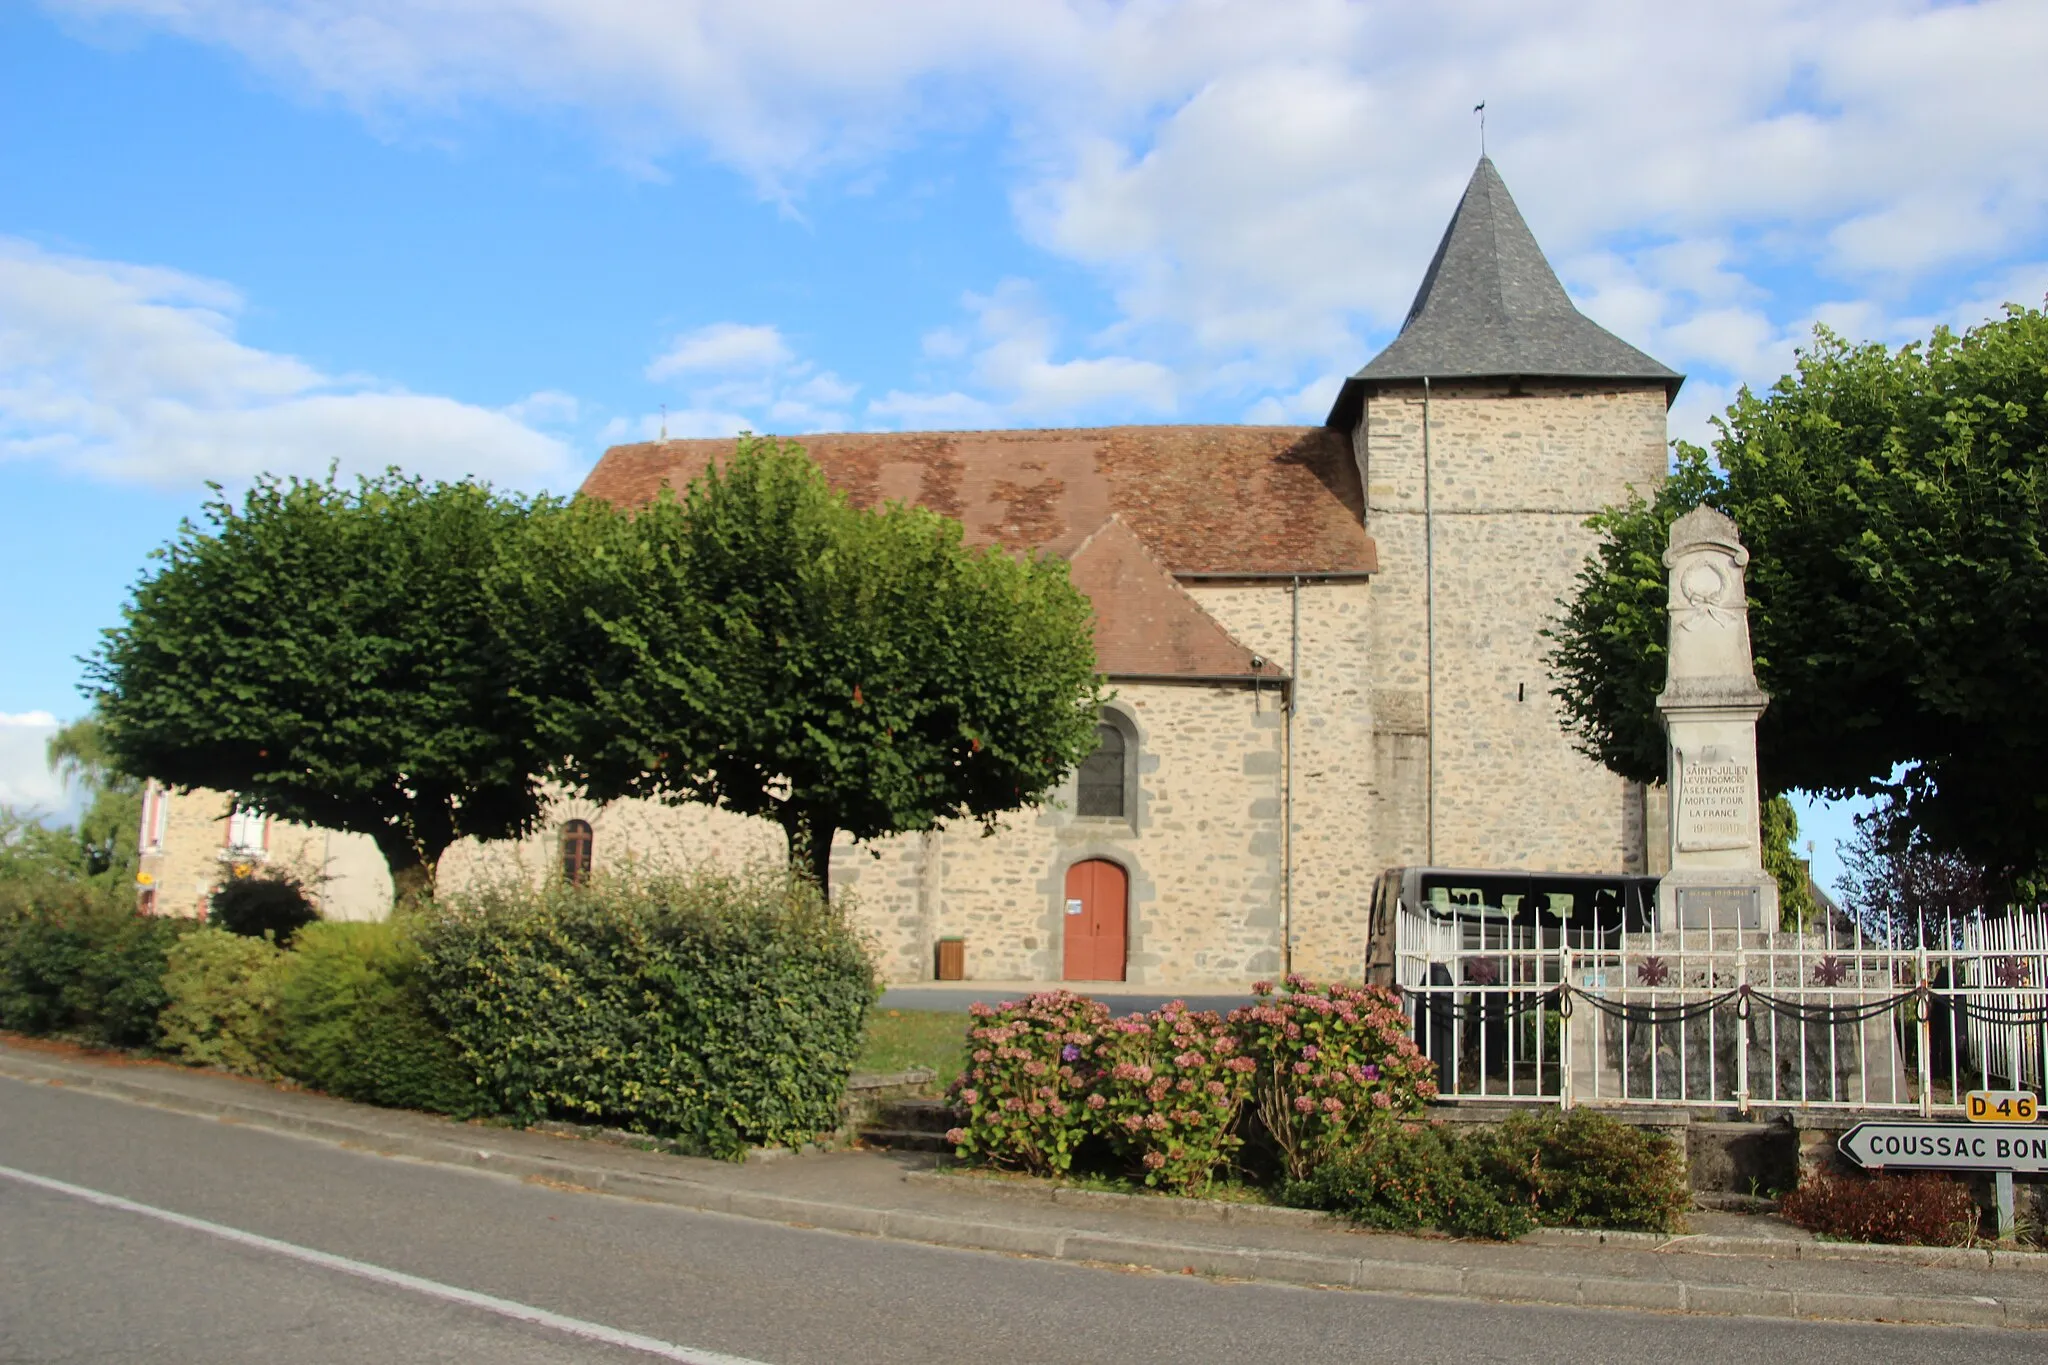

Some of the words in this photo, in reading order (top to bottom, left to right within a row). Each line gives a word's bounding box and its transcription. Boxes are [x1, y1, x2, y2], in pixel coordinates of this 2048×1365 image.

[1685, 765, 1748, 776] SAINT-JULIEN
[1707, 786, 1745, 794] ENFANTS
[1684, 797, 1716, 805] MORTS
[1720, 796, 1744, 805] POUR
[1689, 809, 1701, 817] LA
[1703, 809, 1738, 817] FRANCE
[1972, 1097, 1986, 1116] D
[1996, 1098, 2032, 1117] 46
[1870, 1135, 1986, 1157] COUSSAC
[1997, 1138, 2047, 1159] BON
